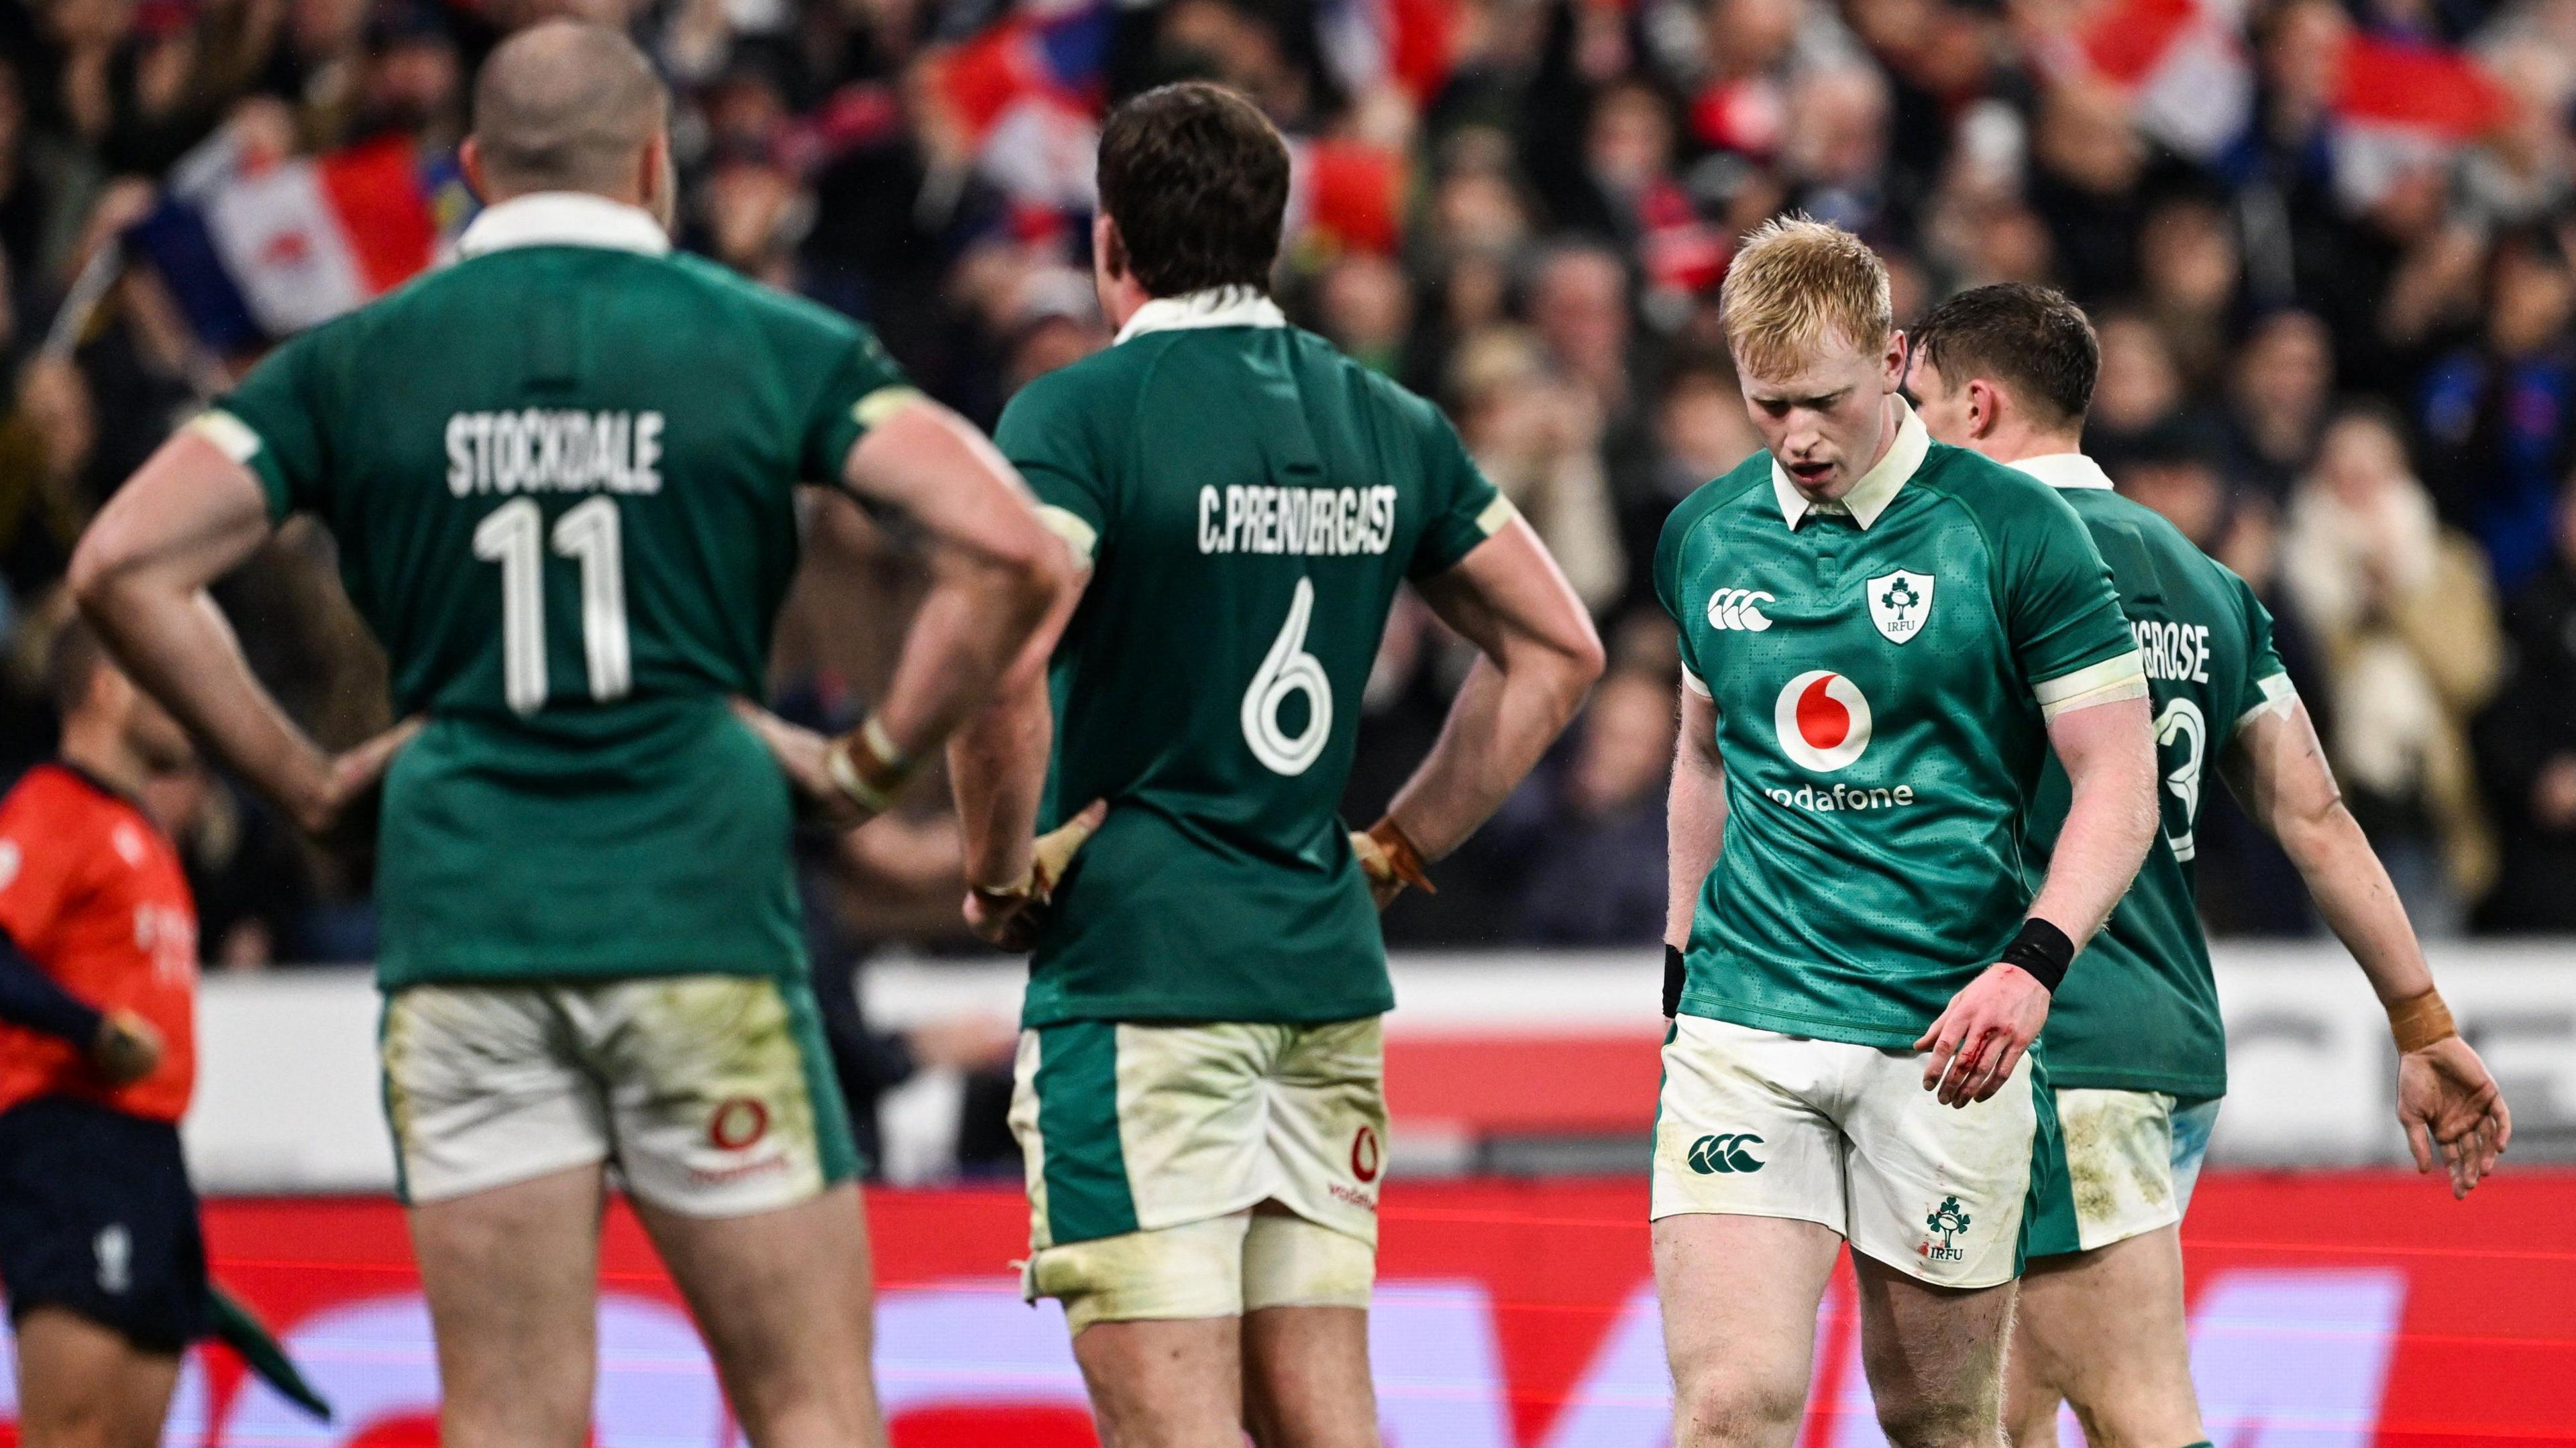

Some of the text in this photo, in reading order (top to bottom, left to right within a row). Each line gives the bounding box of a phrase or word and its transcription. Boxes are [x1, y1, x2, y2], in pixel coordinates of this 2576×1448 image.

[446, 406, 665, 497] STOCKDALE
[472, 495, 632, 715] 11
[1887, 620, 1915, 632] IRFU
[1240, 575, 1333, 777] 6
[1930, 1247, 1964, 1261] IRFU
